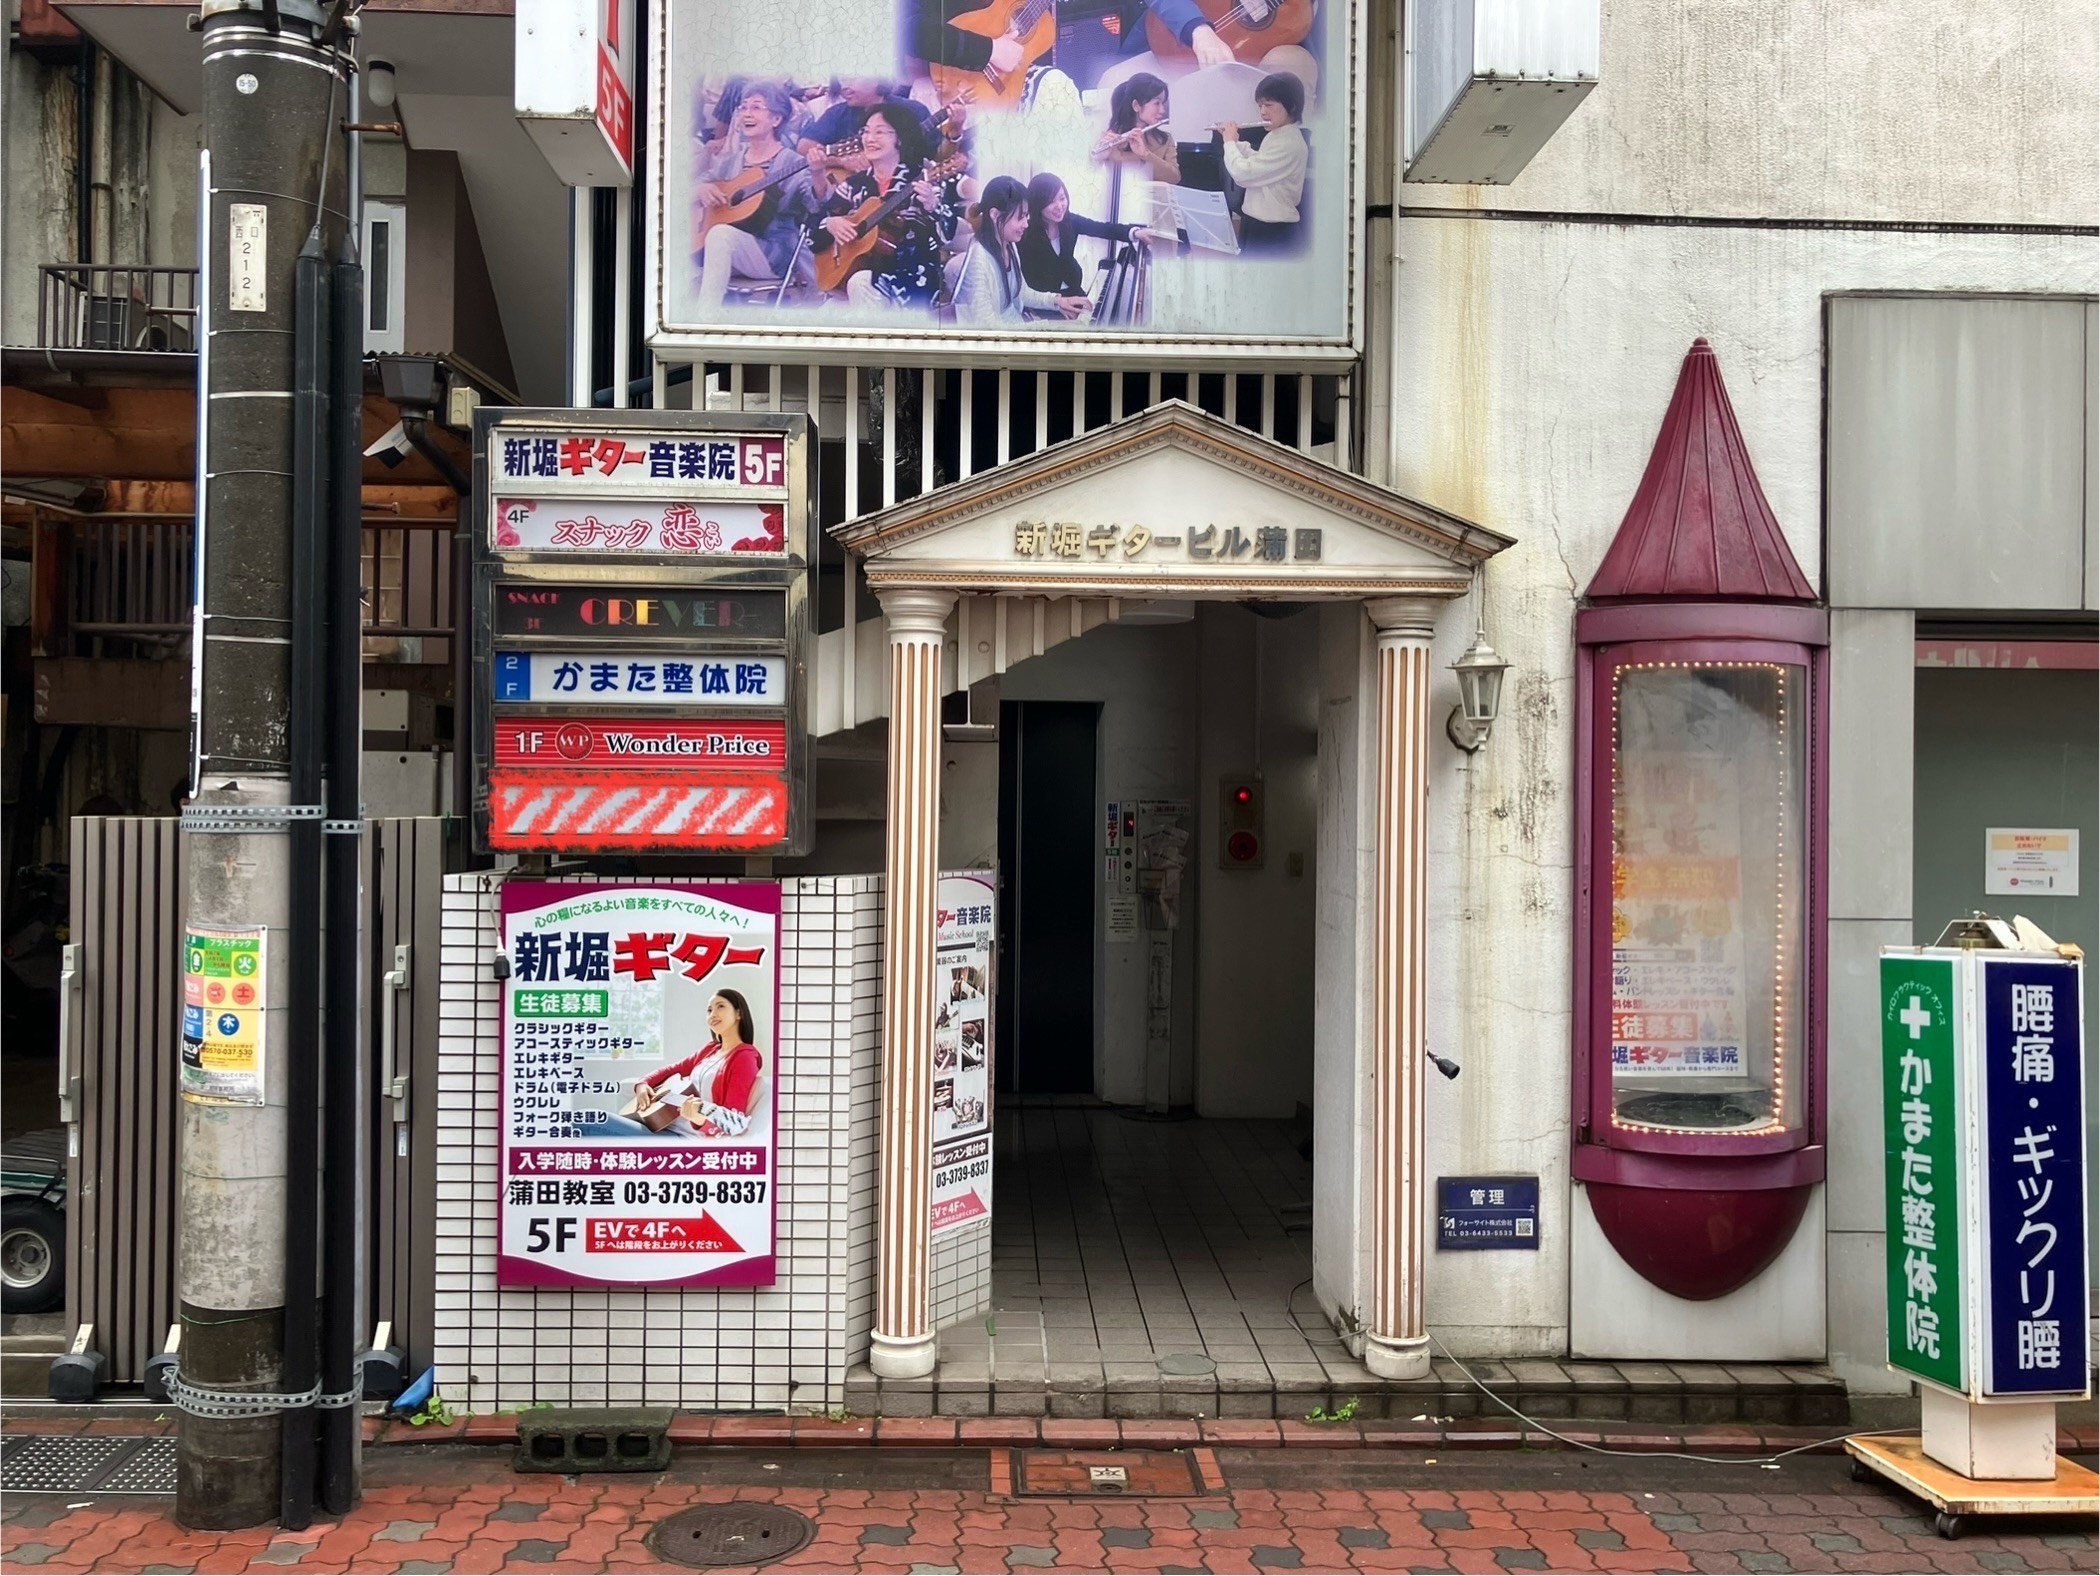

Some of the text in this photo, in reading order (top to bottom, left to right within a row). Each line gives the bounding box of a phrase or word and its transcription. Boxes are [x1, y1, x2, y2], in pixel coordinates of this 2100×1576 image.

[602, 66, 625, 139] 5F
[504, 437, 783, 484] 新堀ギター音楽院 5F
[507, 509, 530, 524] 4F
[551, 516, 652, 548] スナック
[659, 502, 703, 550] 恋
[1015, 521, 1323, 561] 新堀ギタービル蒲田
[507, 592, 560, 605] SNACK
[553, 662, 767, 695] かまた整体院
[515, 731, 544, 754] 1F
[559, 734, 590, 748] WP
[604, 733, 770, 756] Wonder Price
[514, 931, 766, 983] 新堀ギター
[237, 986, 250, 998] 土
[519, 993, 602, 1014] 生徒募集
[514, 1022, 609, 1035] クラシックギター
[514, 1037, 645, 1050] アコースティックギター
[514, 1052, 585, 1065] エレキギター
[513, 1067, 584, 1080] エレキベース
[514, 1081, 620, 1094] ドラム(電子ドラム)
[513, 1096, 560, 1109] ウクレレ
[513, 1111, 607, 1124] フォーク弾き語り
[518, 1151, 758, 1171] 入学随時・体験レッスン受付中
[936, 1159, 988, 1188] 03-3739-8337
[508, 1180, 766, 1206] 蒲田教室 03-3739-8337
[1470, 1189, 1505, 1205] 管理
[1900, 1049, 1940, 1361] かまた整体院
[526, 1217, 577, 1254] 5F
[594, 1221, 686, 1239] EVで4Fへ
